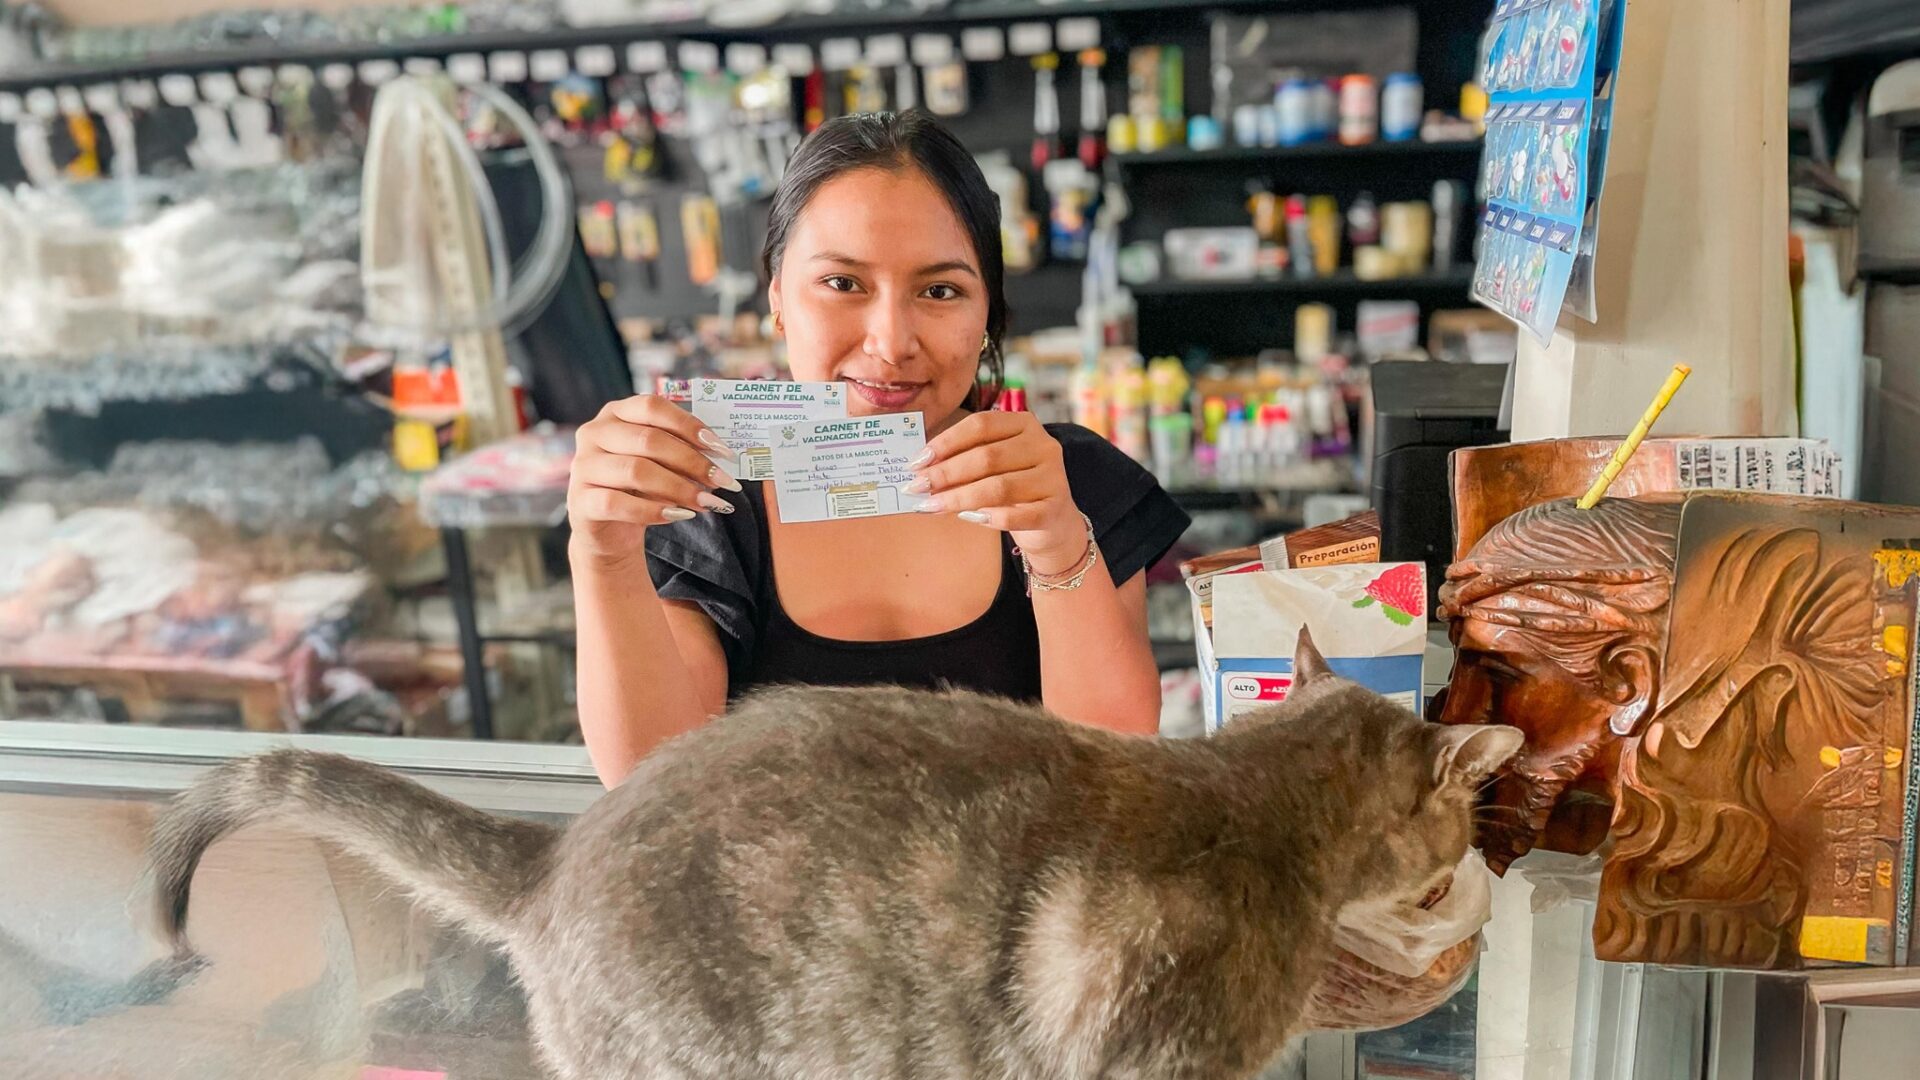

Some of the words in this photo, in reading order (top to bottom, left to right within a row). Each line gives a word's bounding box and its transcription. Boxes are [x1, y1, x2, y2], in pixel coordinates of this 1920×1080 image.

[735, 384, 782, 392] CARNET
[786, 384, 802, 393] DE
[722, 392, 780, 401] VACUNACIÓN
[814, 421, 861, 434] CARNET
[865, 420, 880, 429] DE
[802, 431, 860, 444] VACUNACIÓN
[863, 428, 895, 438] FELINA
[811, 454, 834, 462] DATOS
[1299, 541, 1376, 564] Preparación
[1199, 581, 1213, 591] ALT
[1234, 684, 1256, 692] ALTO
